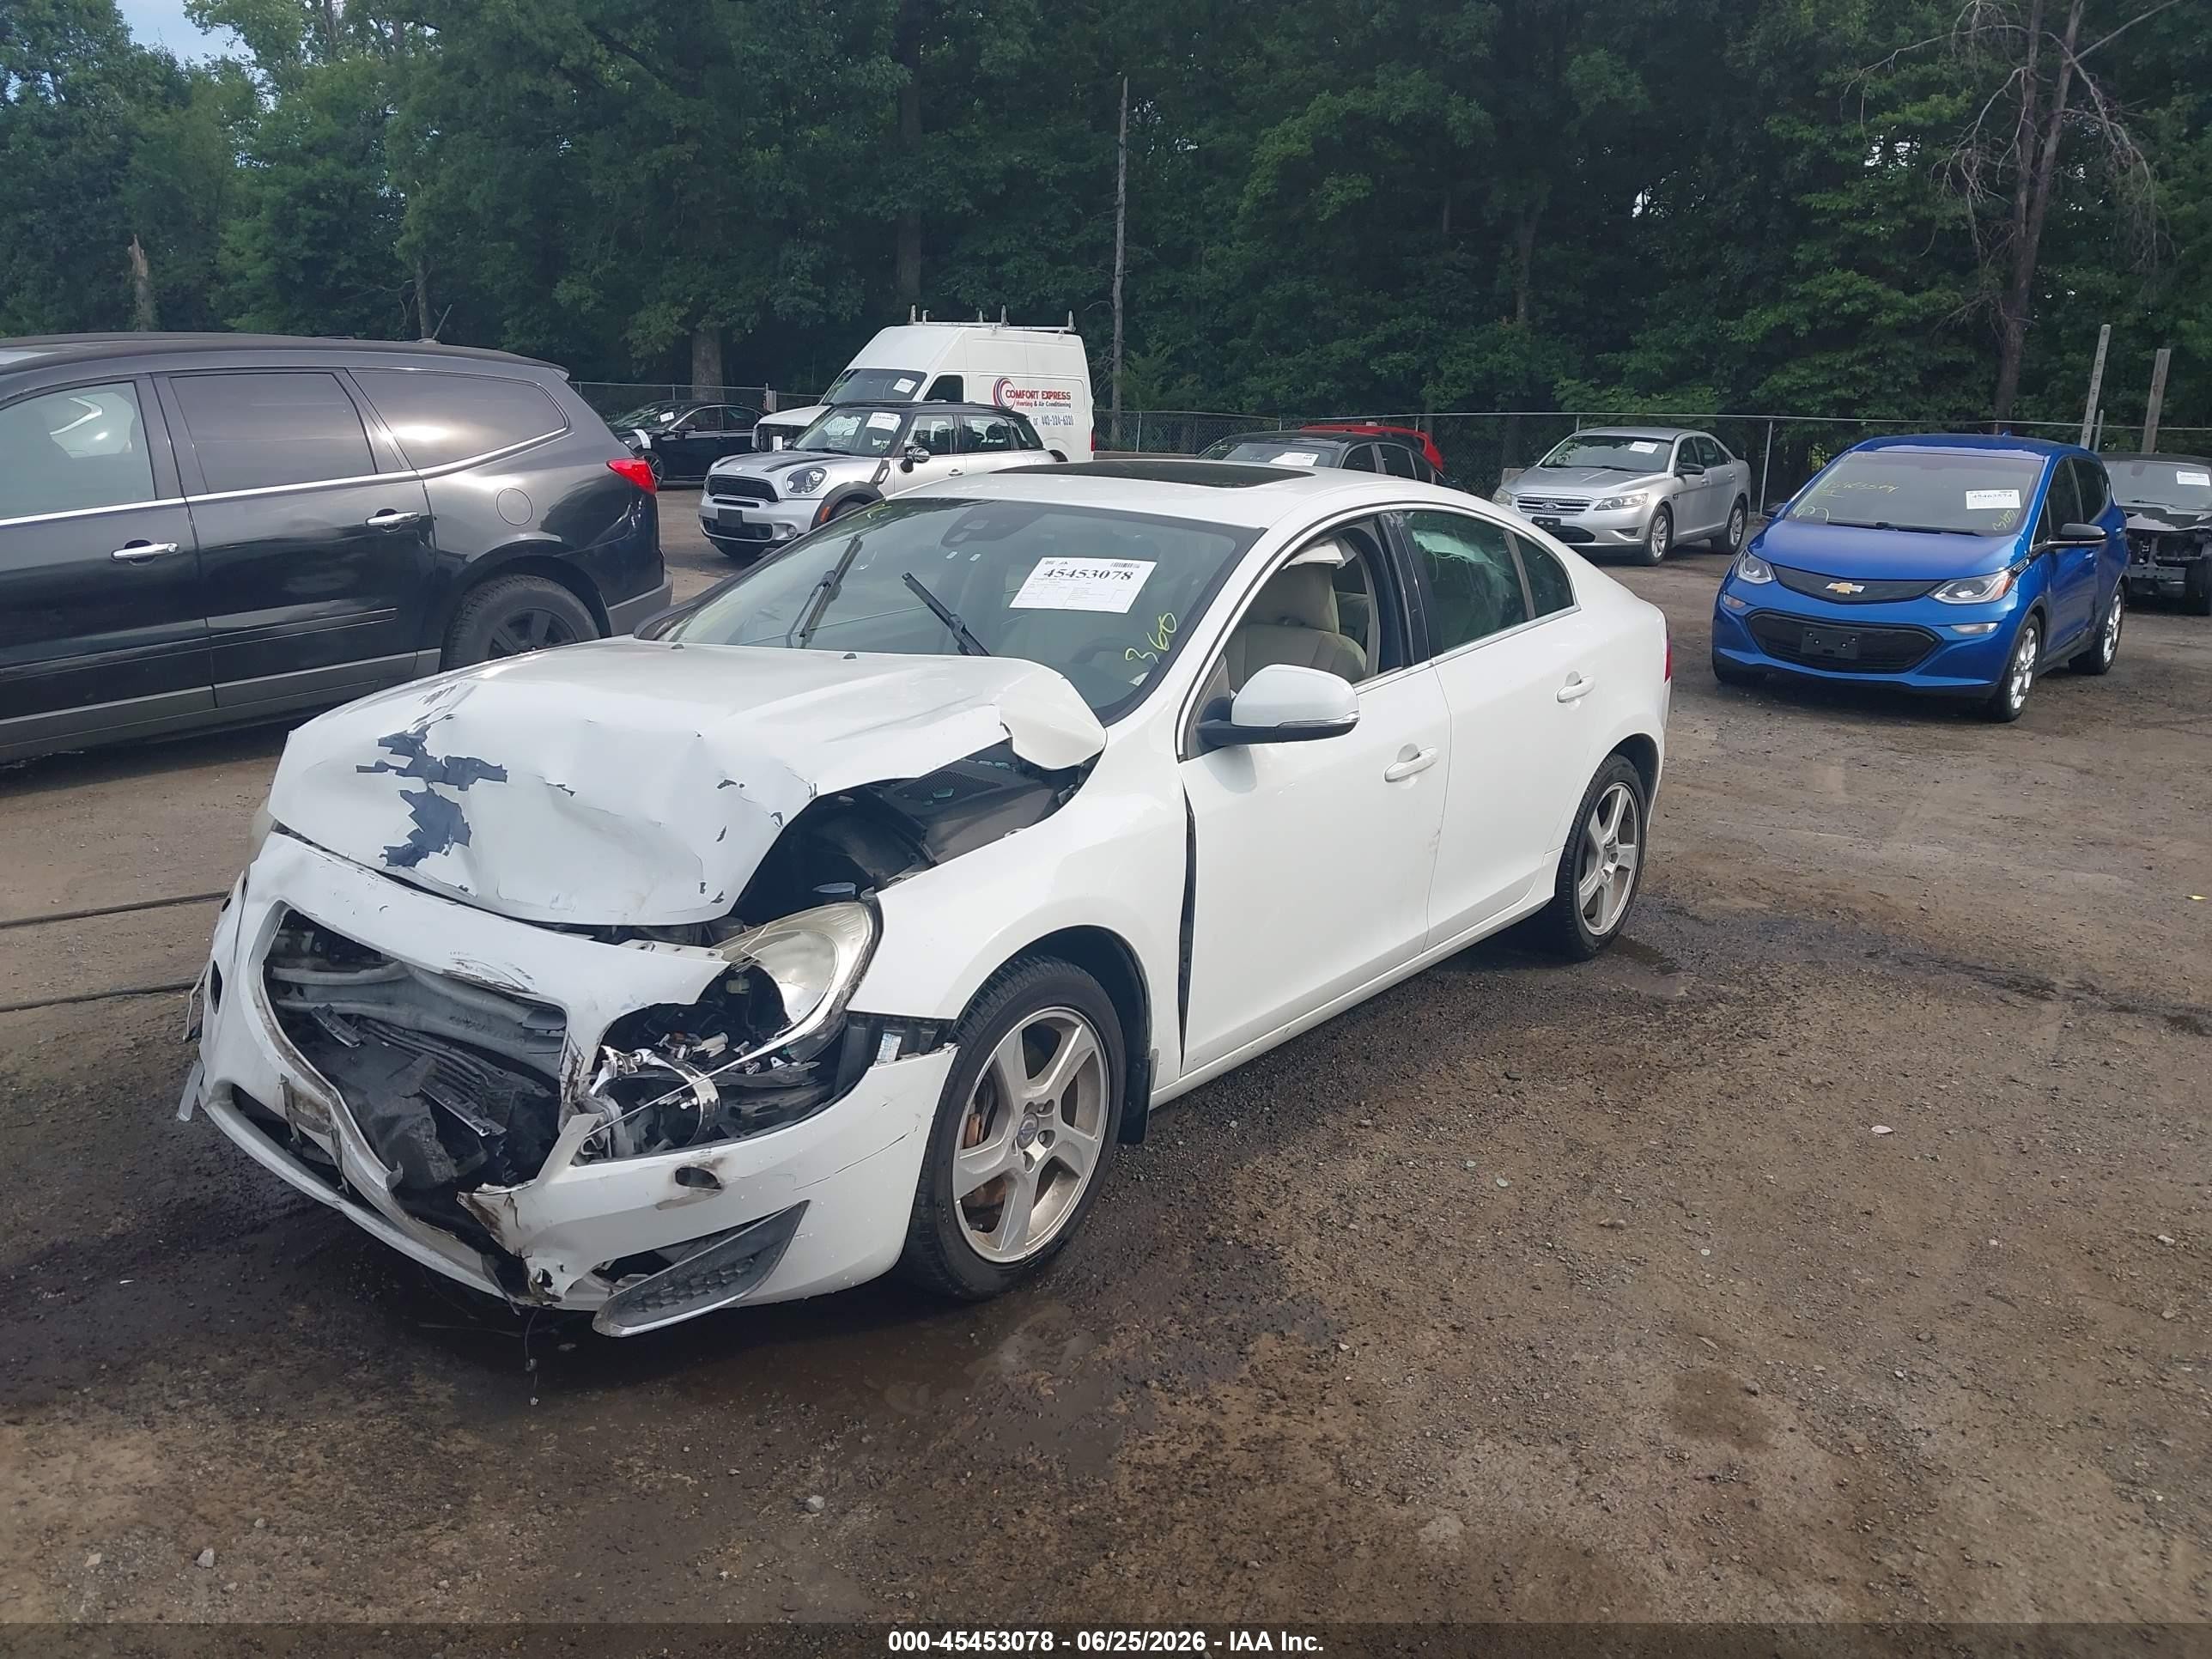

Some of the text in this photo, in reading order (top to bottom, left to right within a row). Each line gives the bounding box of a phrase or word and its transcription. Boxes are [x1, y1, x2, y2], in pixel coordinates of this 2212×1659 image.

[1006, 390, 1071, 400] COMFORT EXPRESS
[1043, 568, 1133, 581] 45453078
[1125, 612, 1177, 664] 360
